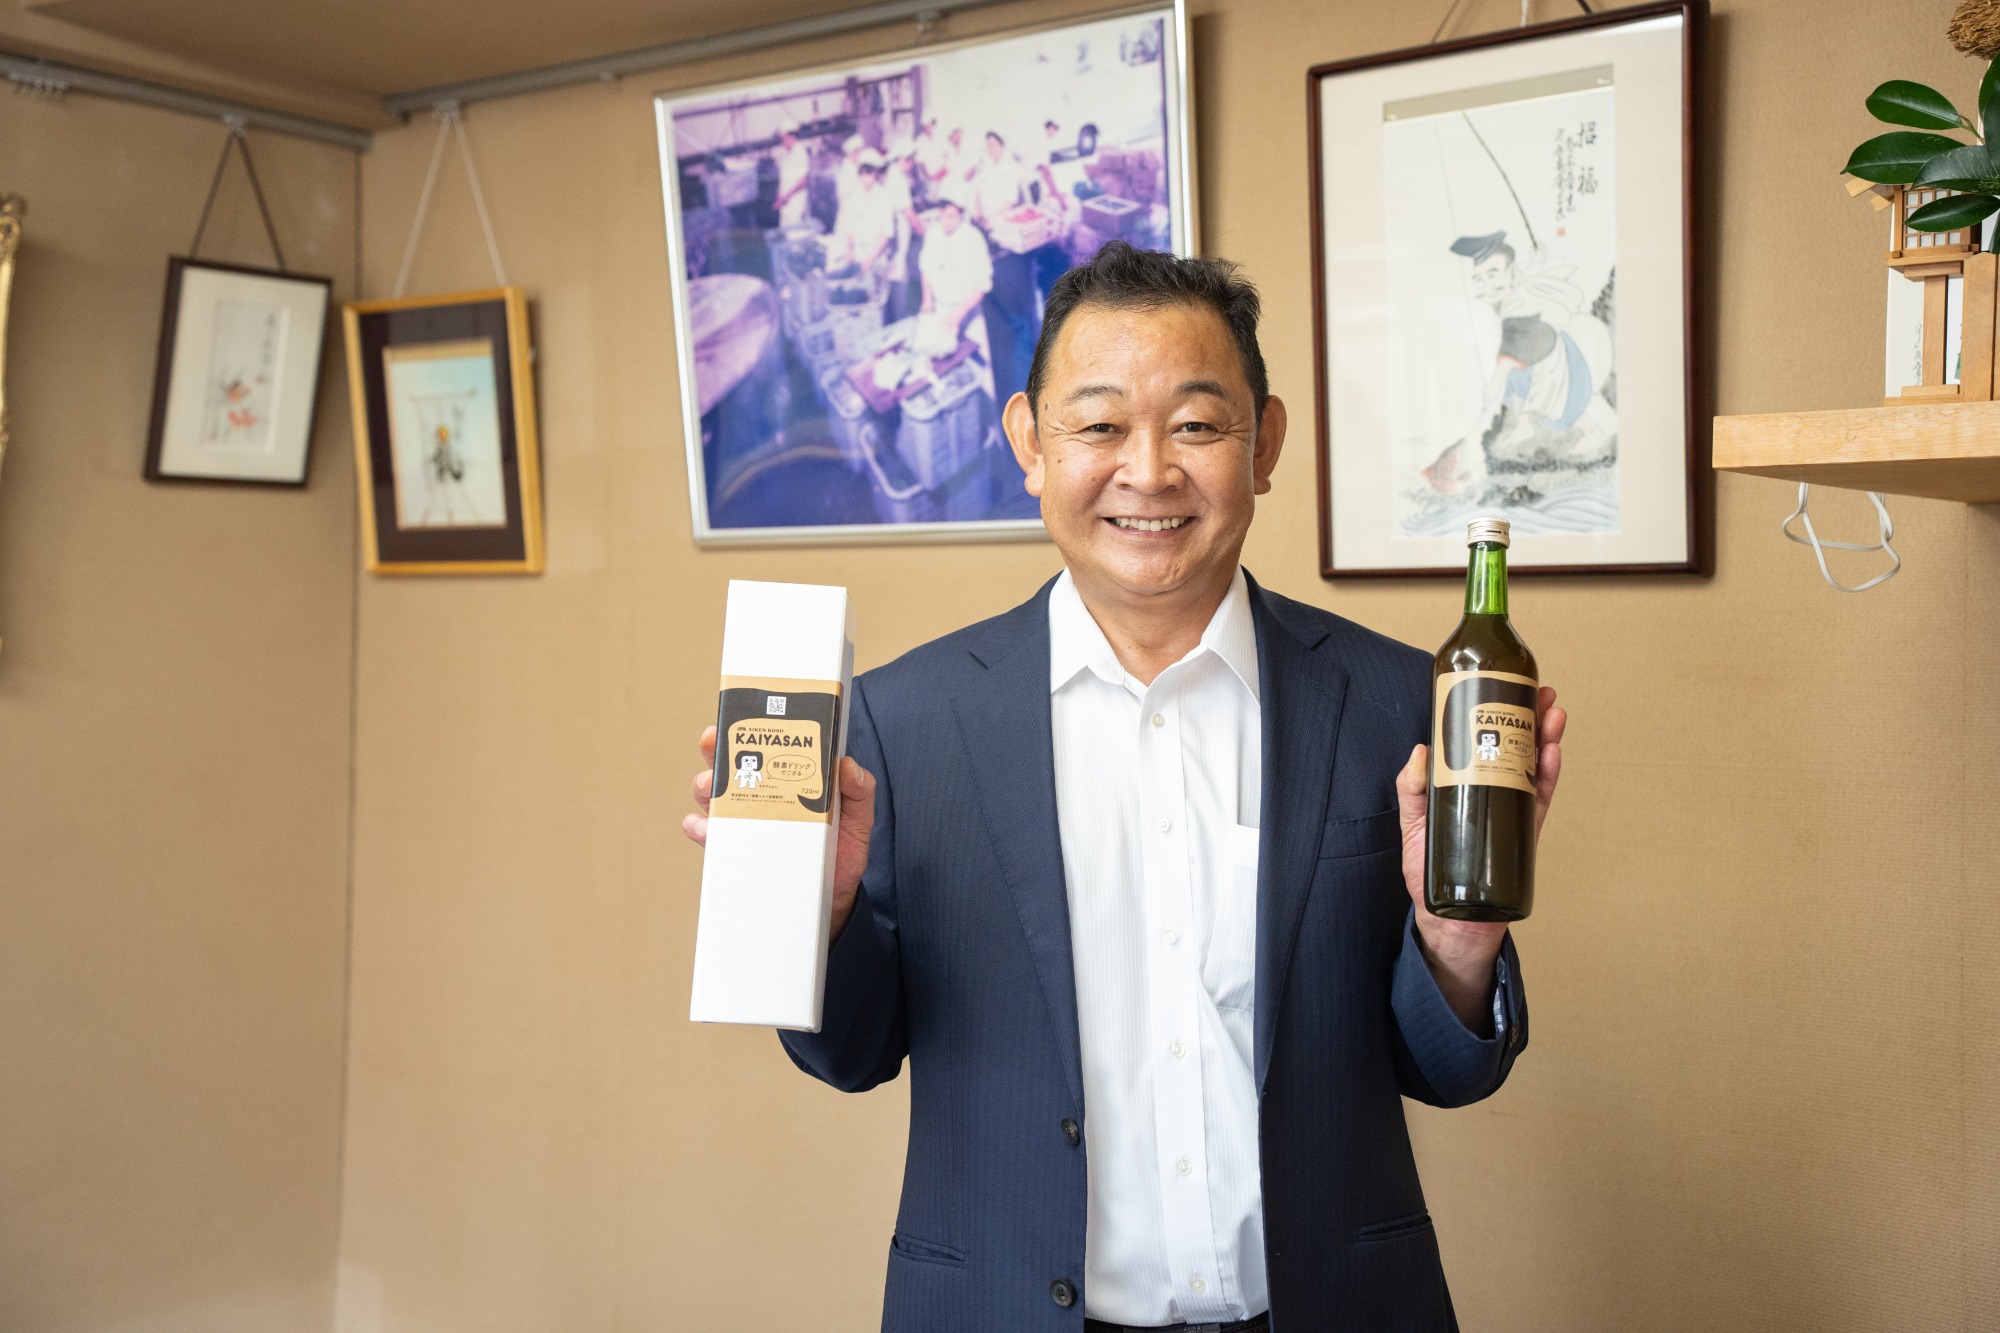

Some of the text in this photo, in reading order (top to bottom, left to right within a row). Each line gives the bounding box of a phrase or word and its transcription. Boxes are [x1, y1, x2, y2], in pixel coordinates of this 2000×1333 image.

[1476, 714, 1532, 732] KAIYASAN
[735, 732, 813, 748] KAIYASAN
[772, 761, 811, 770] 酵素ドリンク
